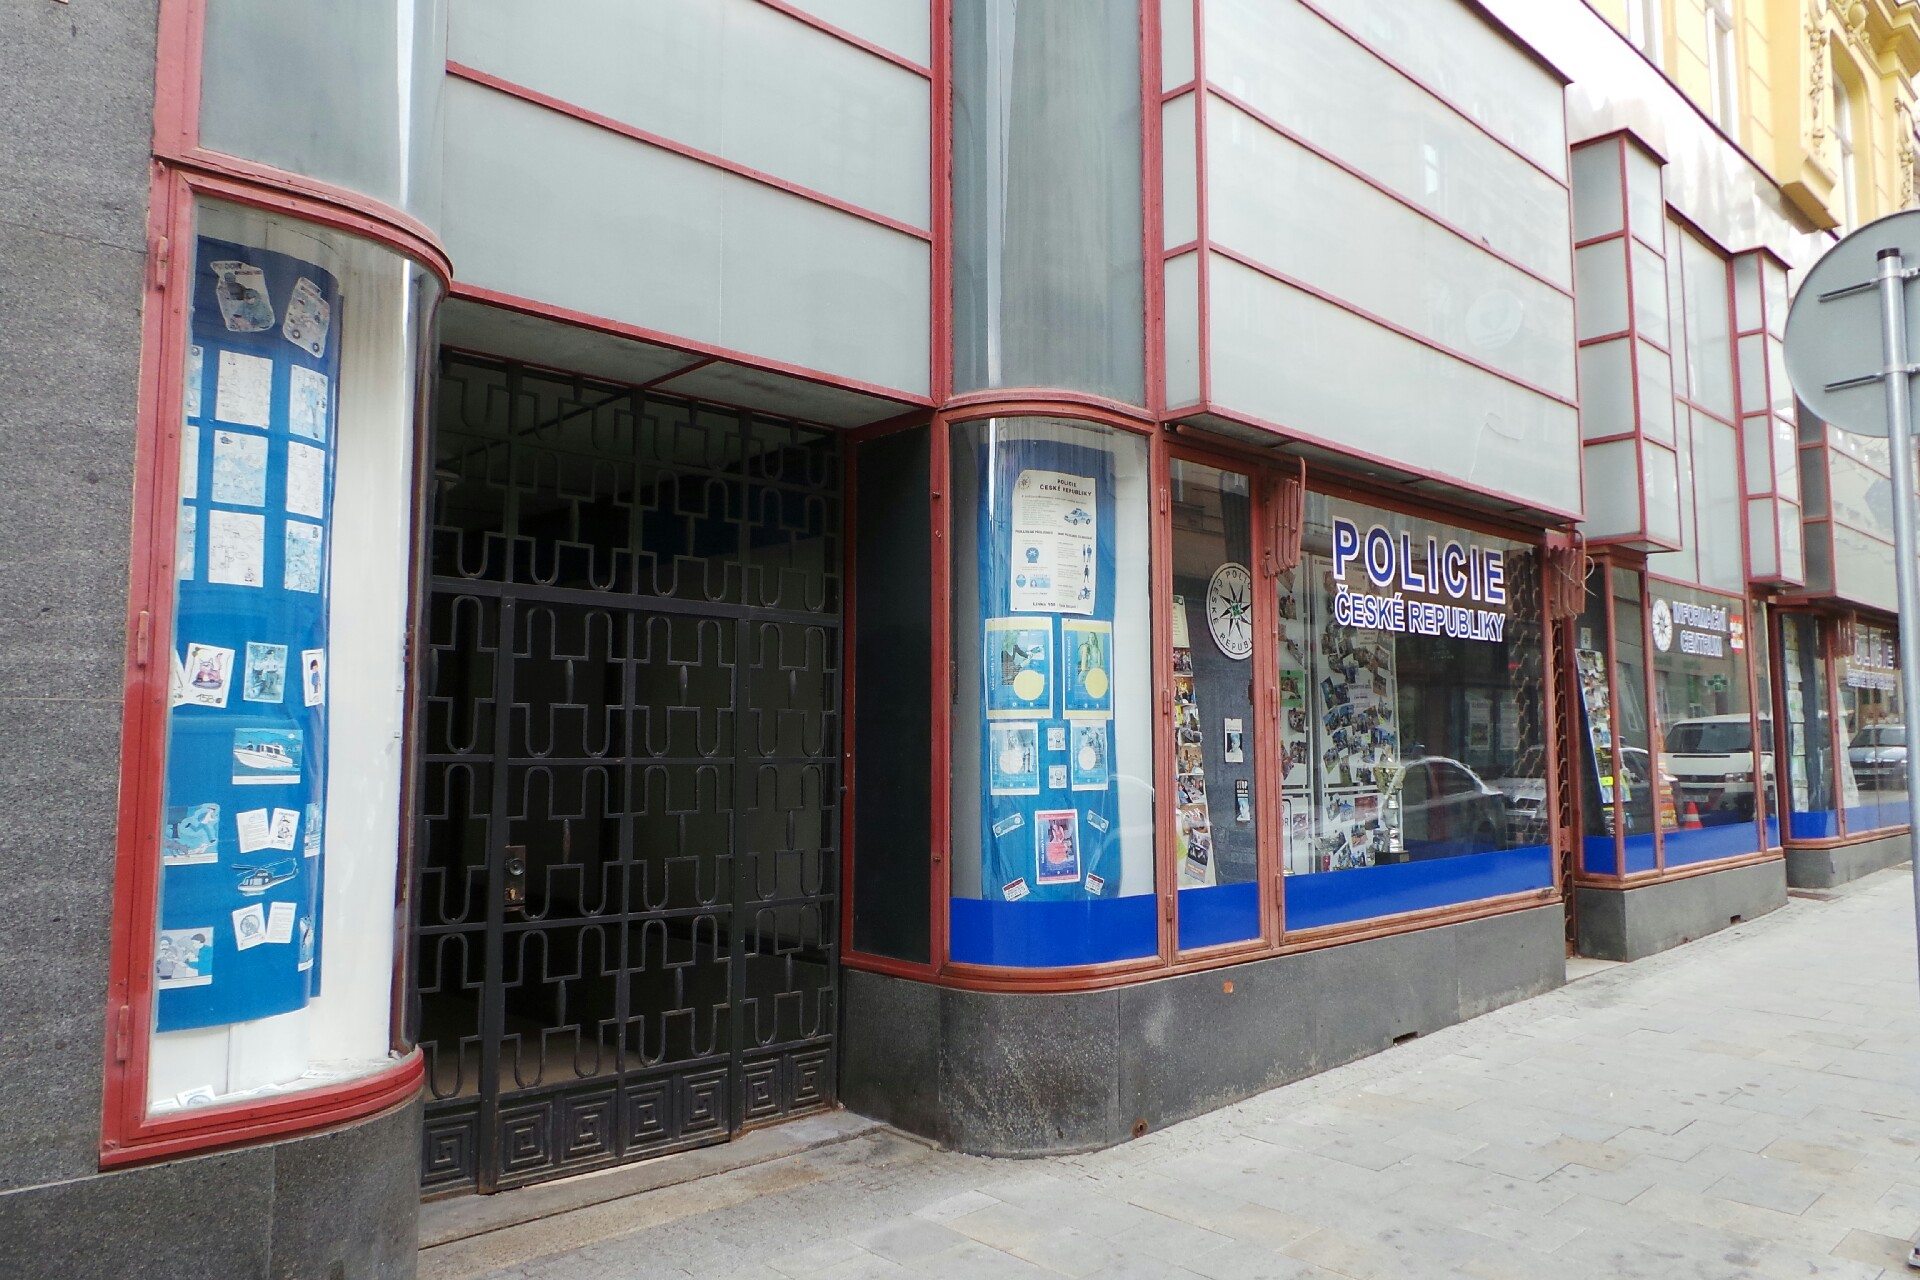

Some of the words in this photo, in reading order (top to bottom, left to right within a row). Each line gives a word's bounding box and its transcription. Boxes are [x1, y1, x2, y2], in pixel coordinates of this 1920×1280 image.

[1333, 516, 1506, 605] POLICIE
[1335, 583, 1405, 631] ČESKÉ
[1408, 601, 1506, 642] REPUBLIKY
[1681, 630, 1722, 657] CENTRUM
